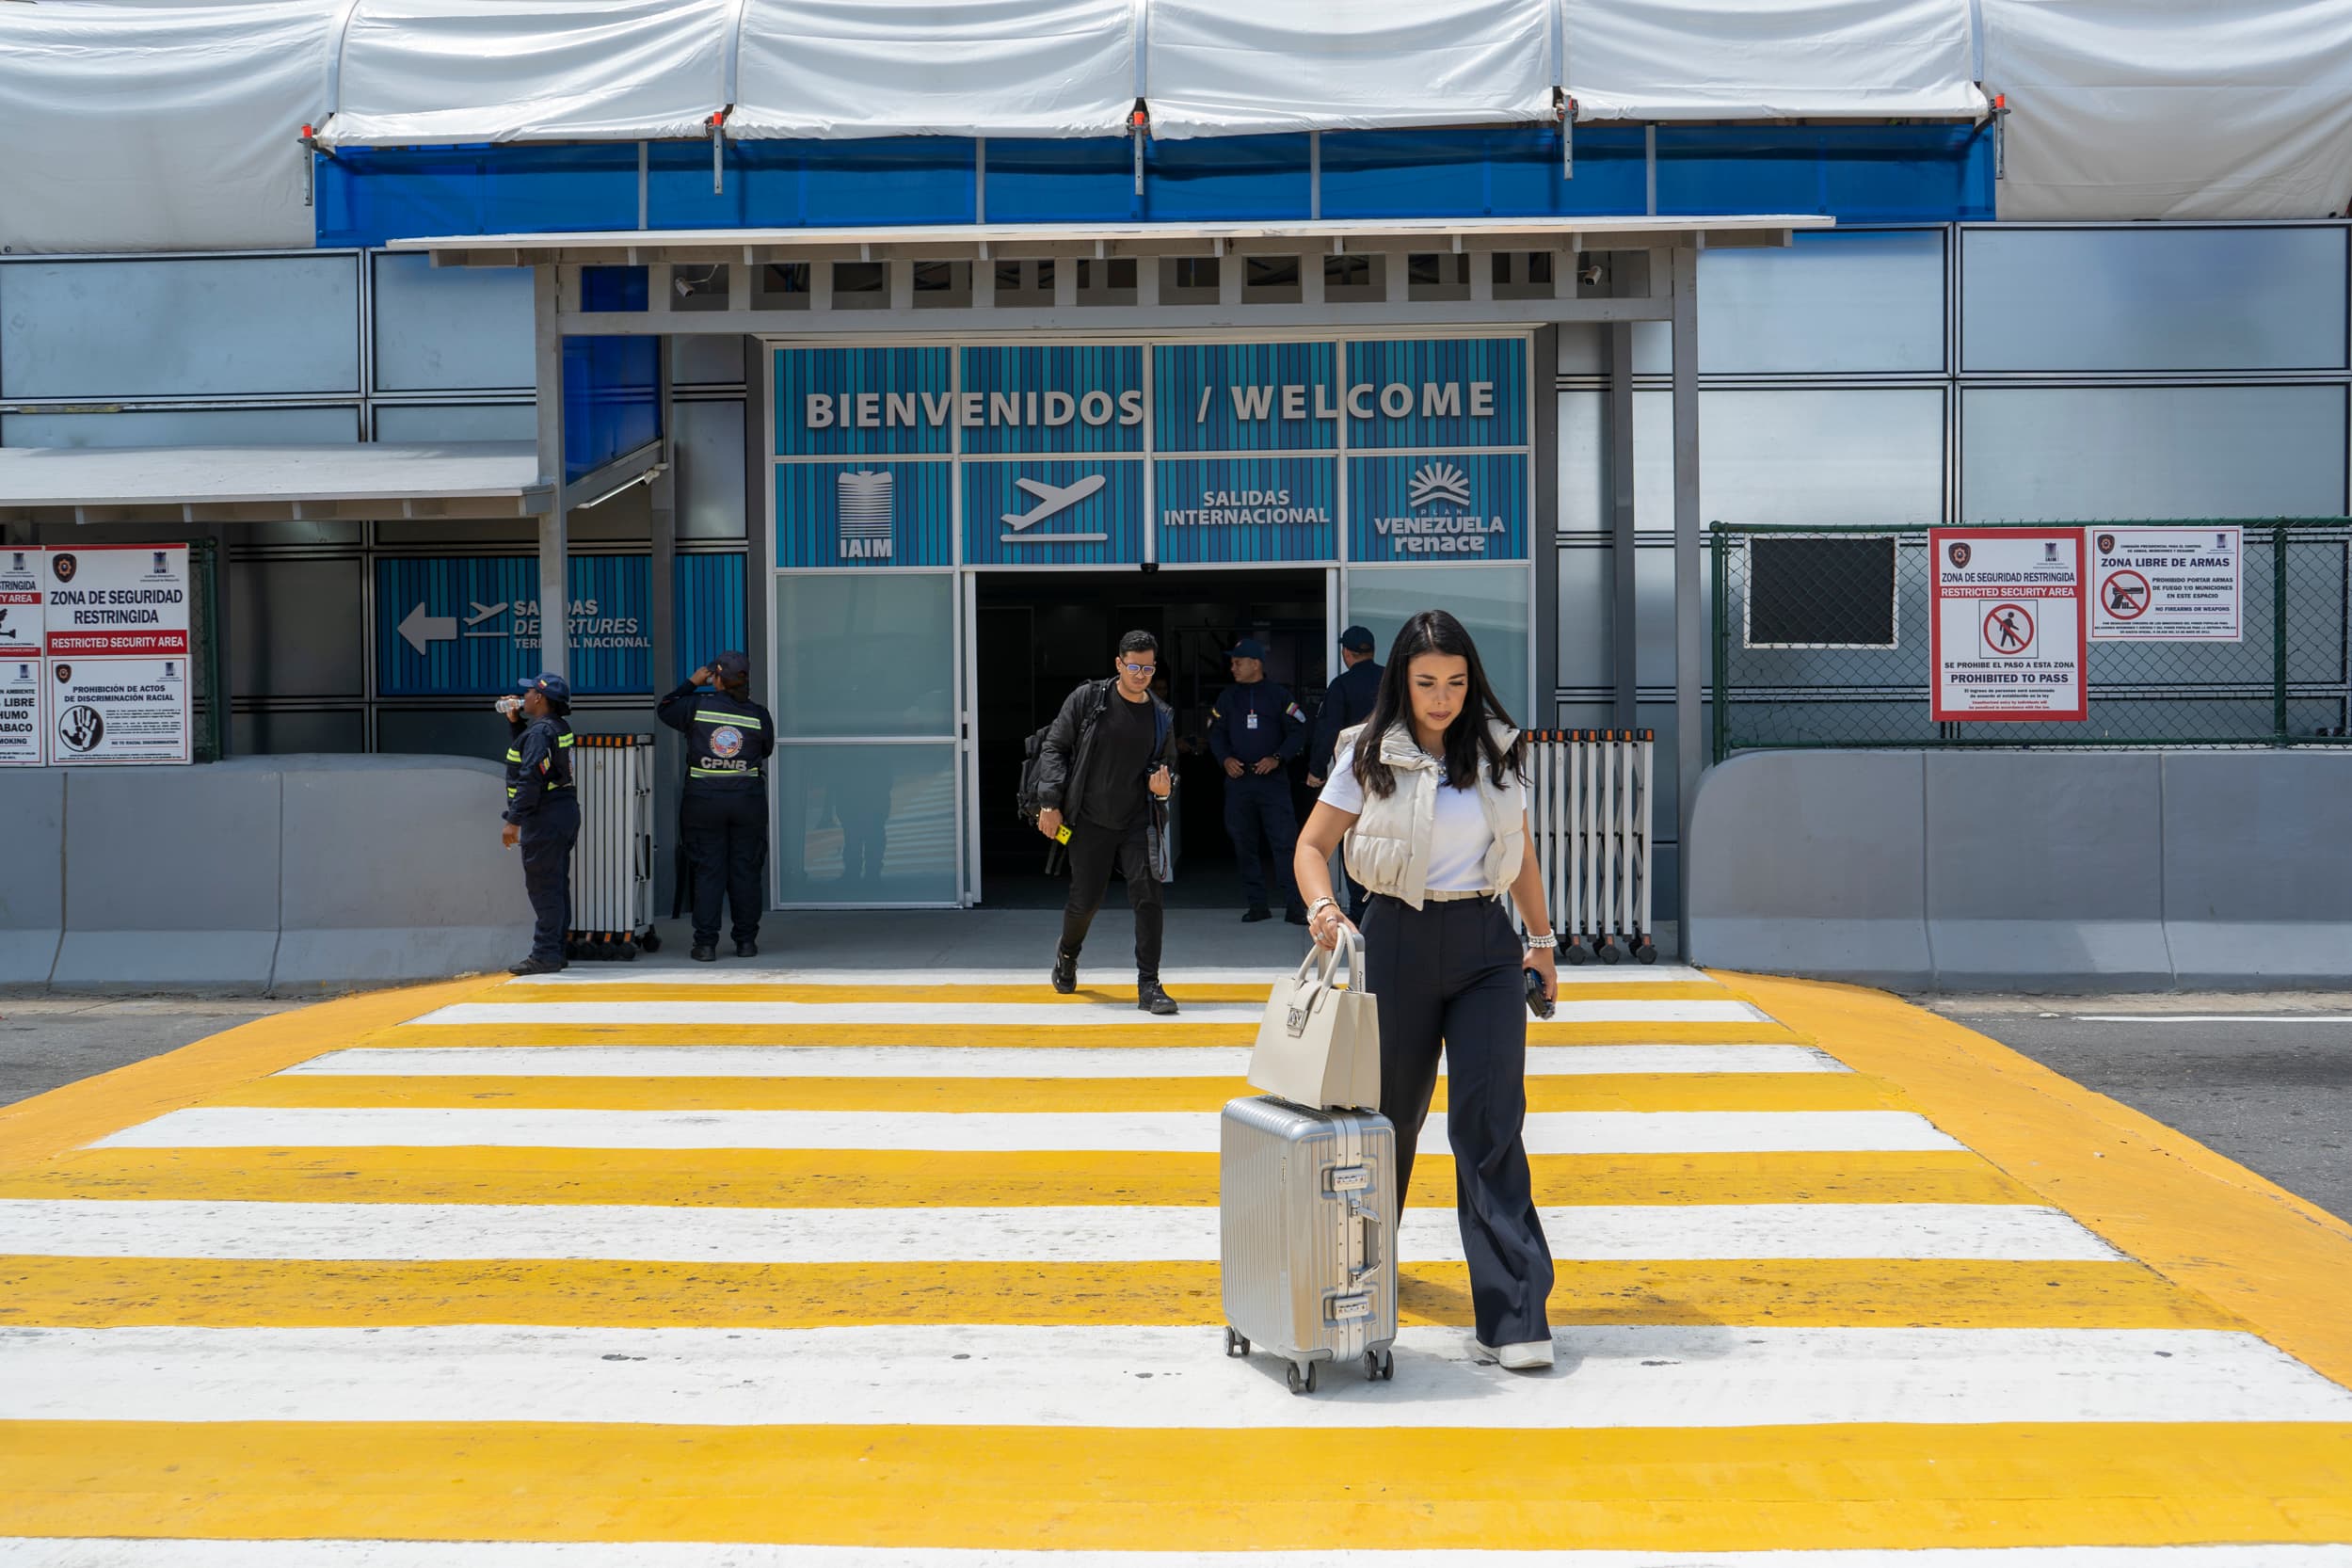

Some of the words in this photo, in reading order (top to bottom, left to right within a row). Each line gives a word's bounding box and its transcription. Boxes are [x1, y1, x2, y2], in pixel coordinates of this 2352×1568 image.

[807, 391, 1144, 428] BIENVENIDOS
[1196, 386, 1212, 423] /
[1231, 381, 1495, 421] WELCOME
[1203, 489, 1289, 506] SALIDAS
[1163, 508, 1330, 525] INTERNACIONAL
[1374, 516, 1506, 535] VENEZUELA
[840, 538, 892, 557] IAIM
[1395, 536, 1485, 552] renace
[2101, 558, 2132, 567] ZONA
[2136, 558, 2168, 567] LIBRE
[2171, 558, 2186, 567] DE
[2189, 558, 2230, 567] ARMAS
[1942, 572, 1963, 582] ZONA
[1965, 572, 1975, 582] DE
[1976, 572, 2022, 582] SEGURIDAD
[2024, 572, 2074, 582] RESTRINGIDA
[0, 581, 36, 591] TRINGIDA
[1941, 588, 1999, 597] RESTRICTED
[2001, 588, 2047, 597] SECURITY
[2049, 588, 2074, 597] AREA
[51, 591, 86, 605] ZONA
[88, 590, 105, 604] DE
[109, 589, 183, 604] SEGURIDAD
[514, 600, 599, 616] SAAS
[74, 610, 159, 624] RESTRINGIDA
[52, 638, 108, 648] RESTRICTED
[110, 637, 156, 648] SECURITY
[158, 636, 184, 648] AREA
[584, 638, 651, 648] NACIONAL
[1951, 674, 2018, 682] PROHIBITED
[2022, 674, 2035, 682] TO
[2040, 674, 2069, 682] PASS
[73, 684, 124, 693] PROHIBICIÓN
[5, 698, 35, 707] LIBRE
[77, 694, 144, 702] DISCRIMINACIÓN
[700, 757, 747, 772] CPNB
